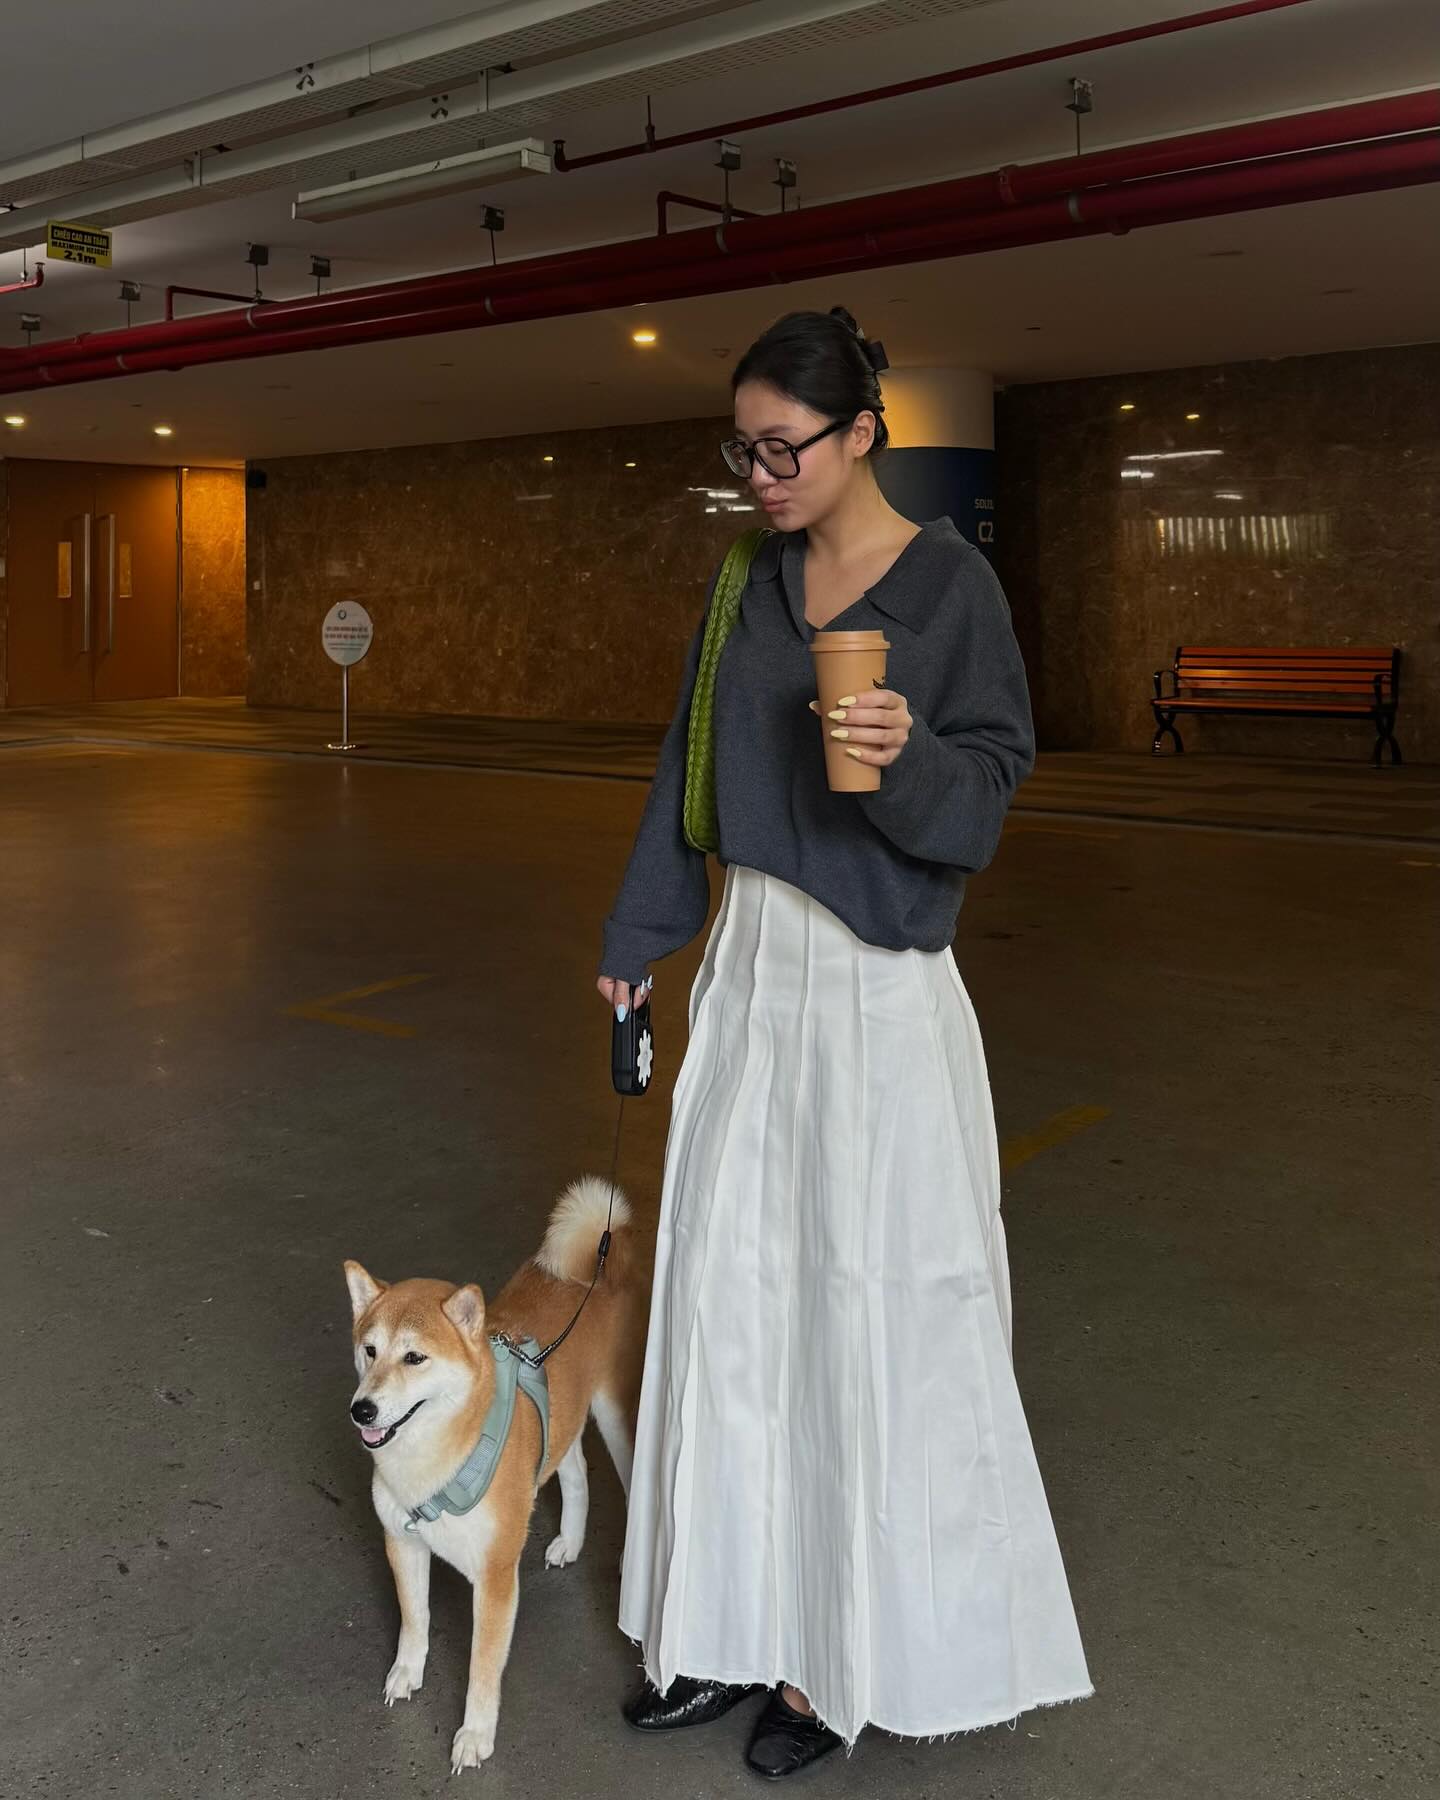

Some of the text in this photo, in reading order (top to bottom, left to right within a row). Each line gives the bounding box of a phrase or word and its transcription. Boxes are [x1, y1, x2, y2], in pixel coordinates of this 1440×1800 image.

[52, 241, 108, 256] MAXIMUM HEIGHT
[64, 250, 96, 264] 2.1m
